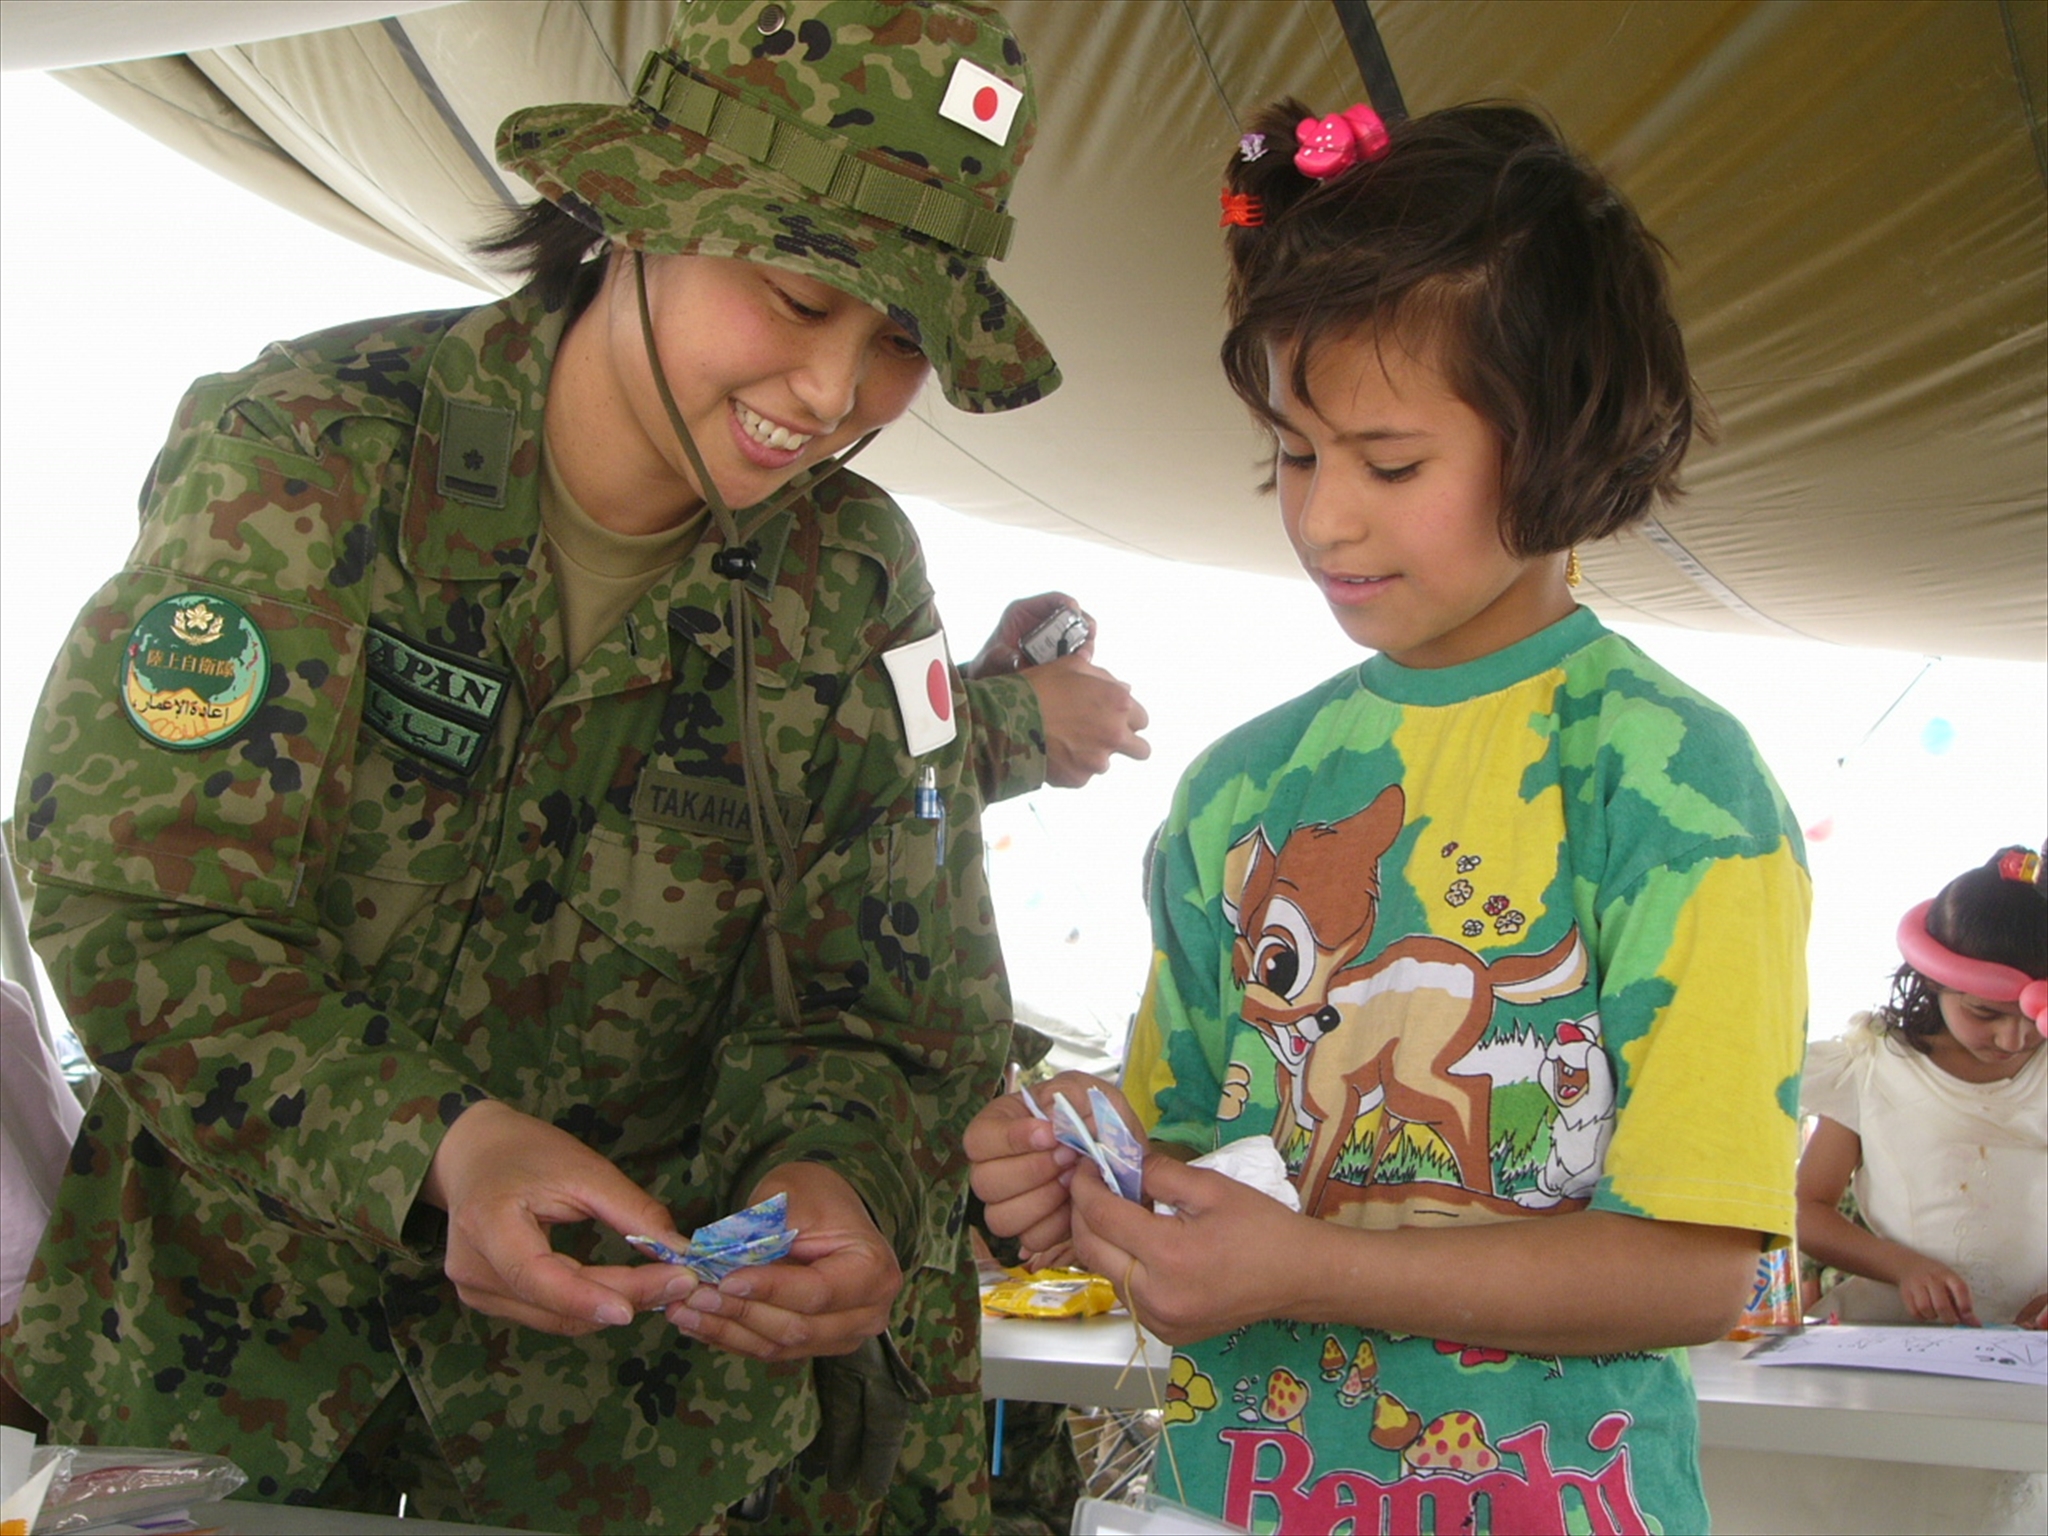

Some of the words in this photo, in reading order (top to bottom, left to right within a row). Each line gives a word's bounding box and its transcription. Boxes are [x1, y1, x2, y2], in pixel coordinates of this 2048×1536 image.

[367, 636, 495, 709] APAN
[372, 690, 472, 756] اليابا
[1219, 1411, 1650, 1535] Bambi
